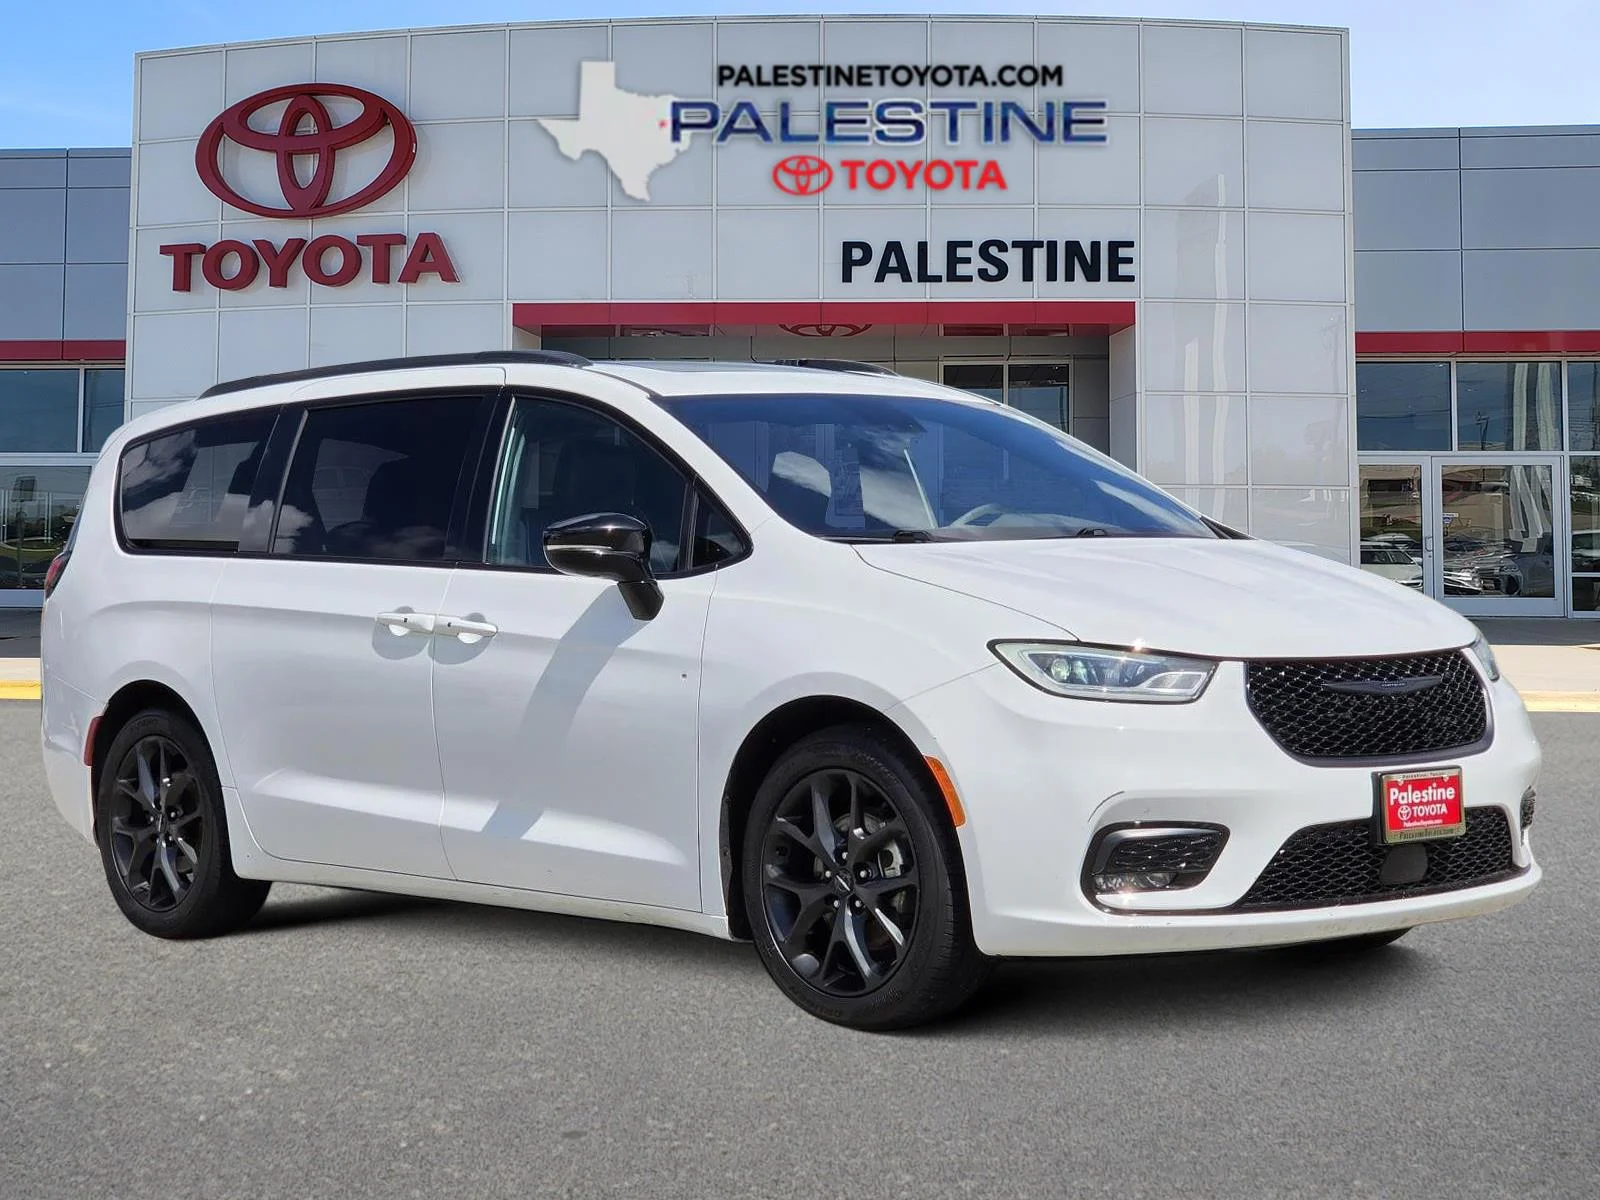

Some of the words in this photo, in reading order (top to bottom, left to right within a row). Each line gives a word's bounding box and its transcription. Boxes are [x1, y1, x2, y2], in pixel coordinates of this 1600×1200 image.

[159, 231, 462, 293] TOYOTA
[841, 239, 1136, 284] PALESTINE
[1389, 782, 1456, 806] Palestine
[1412, 803, 1448, 817] TOYOTA
